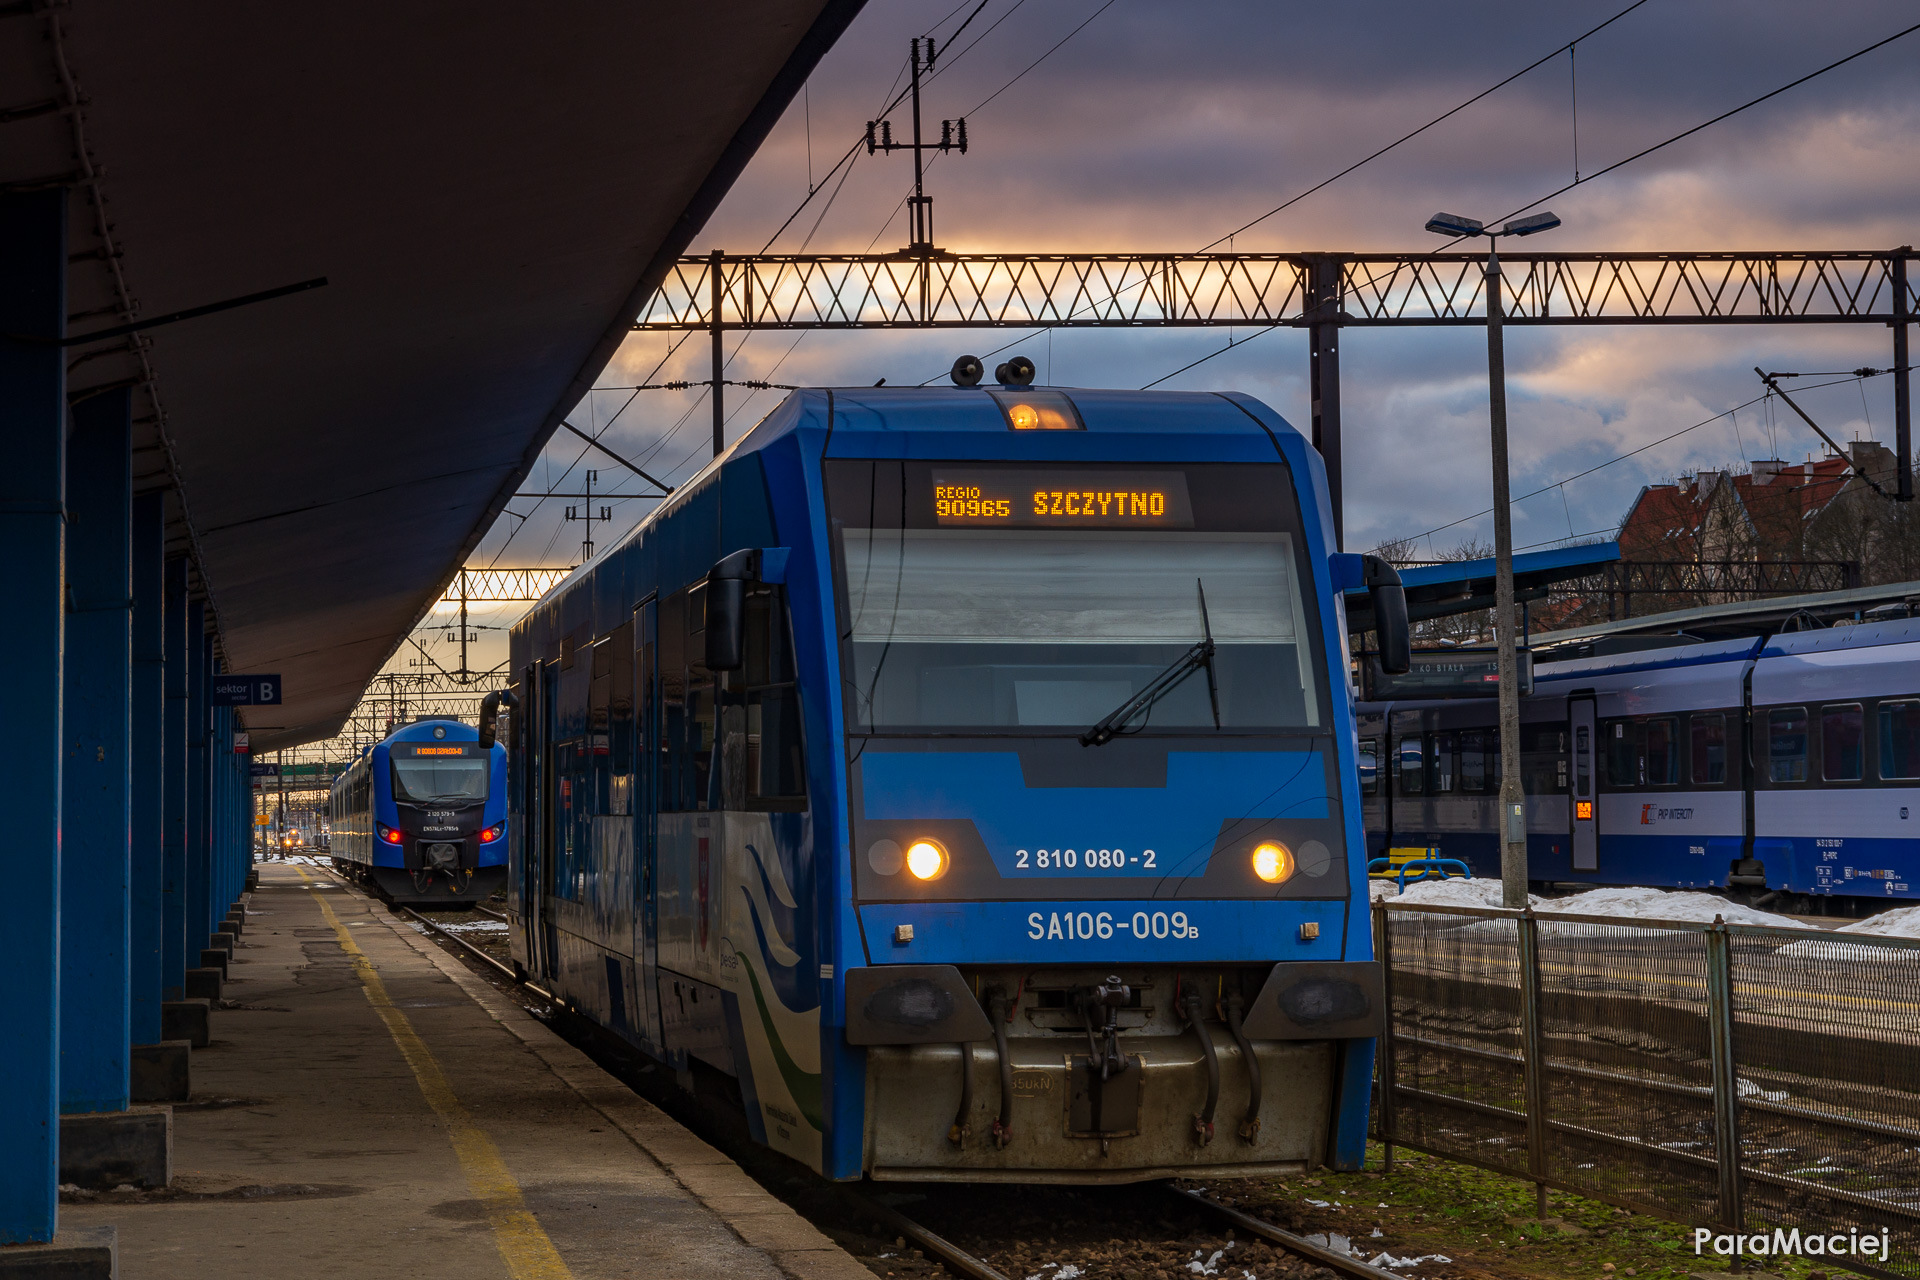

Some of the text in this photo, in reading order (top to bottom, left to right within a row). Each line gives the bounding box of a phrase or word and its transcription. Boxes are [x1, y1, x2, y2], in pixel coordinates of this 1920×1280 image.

[936, 486, 980, 499] REGIO
[936, 499, 1010, 517] 90965
[1034, 491, 1164, 516] SZCZYTNO
[216, 682, 274, 701] sektor B
[267, 766, 275, 775] A
[1015, 850, 1029, 868] 2
[1036, 850, 1077, 868] 810
